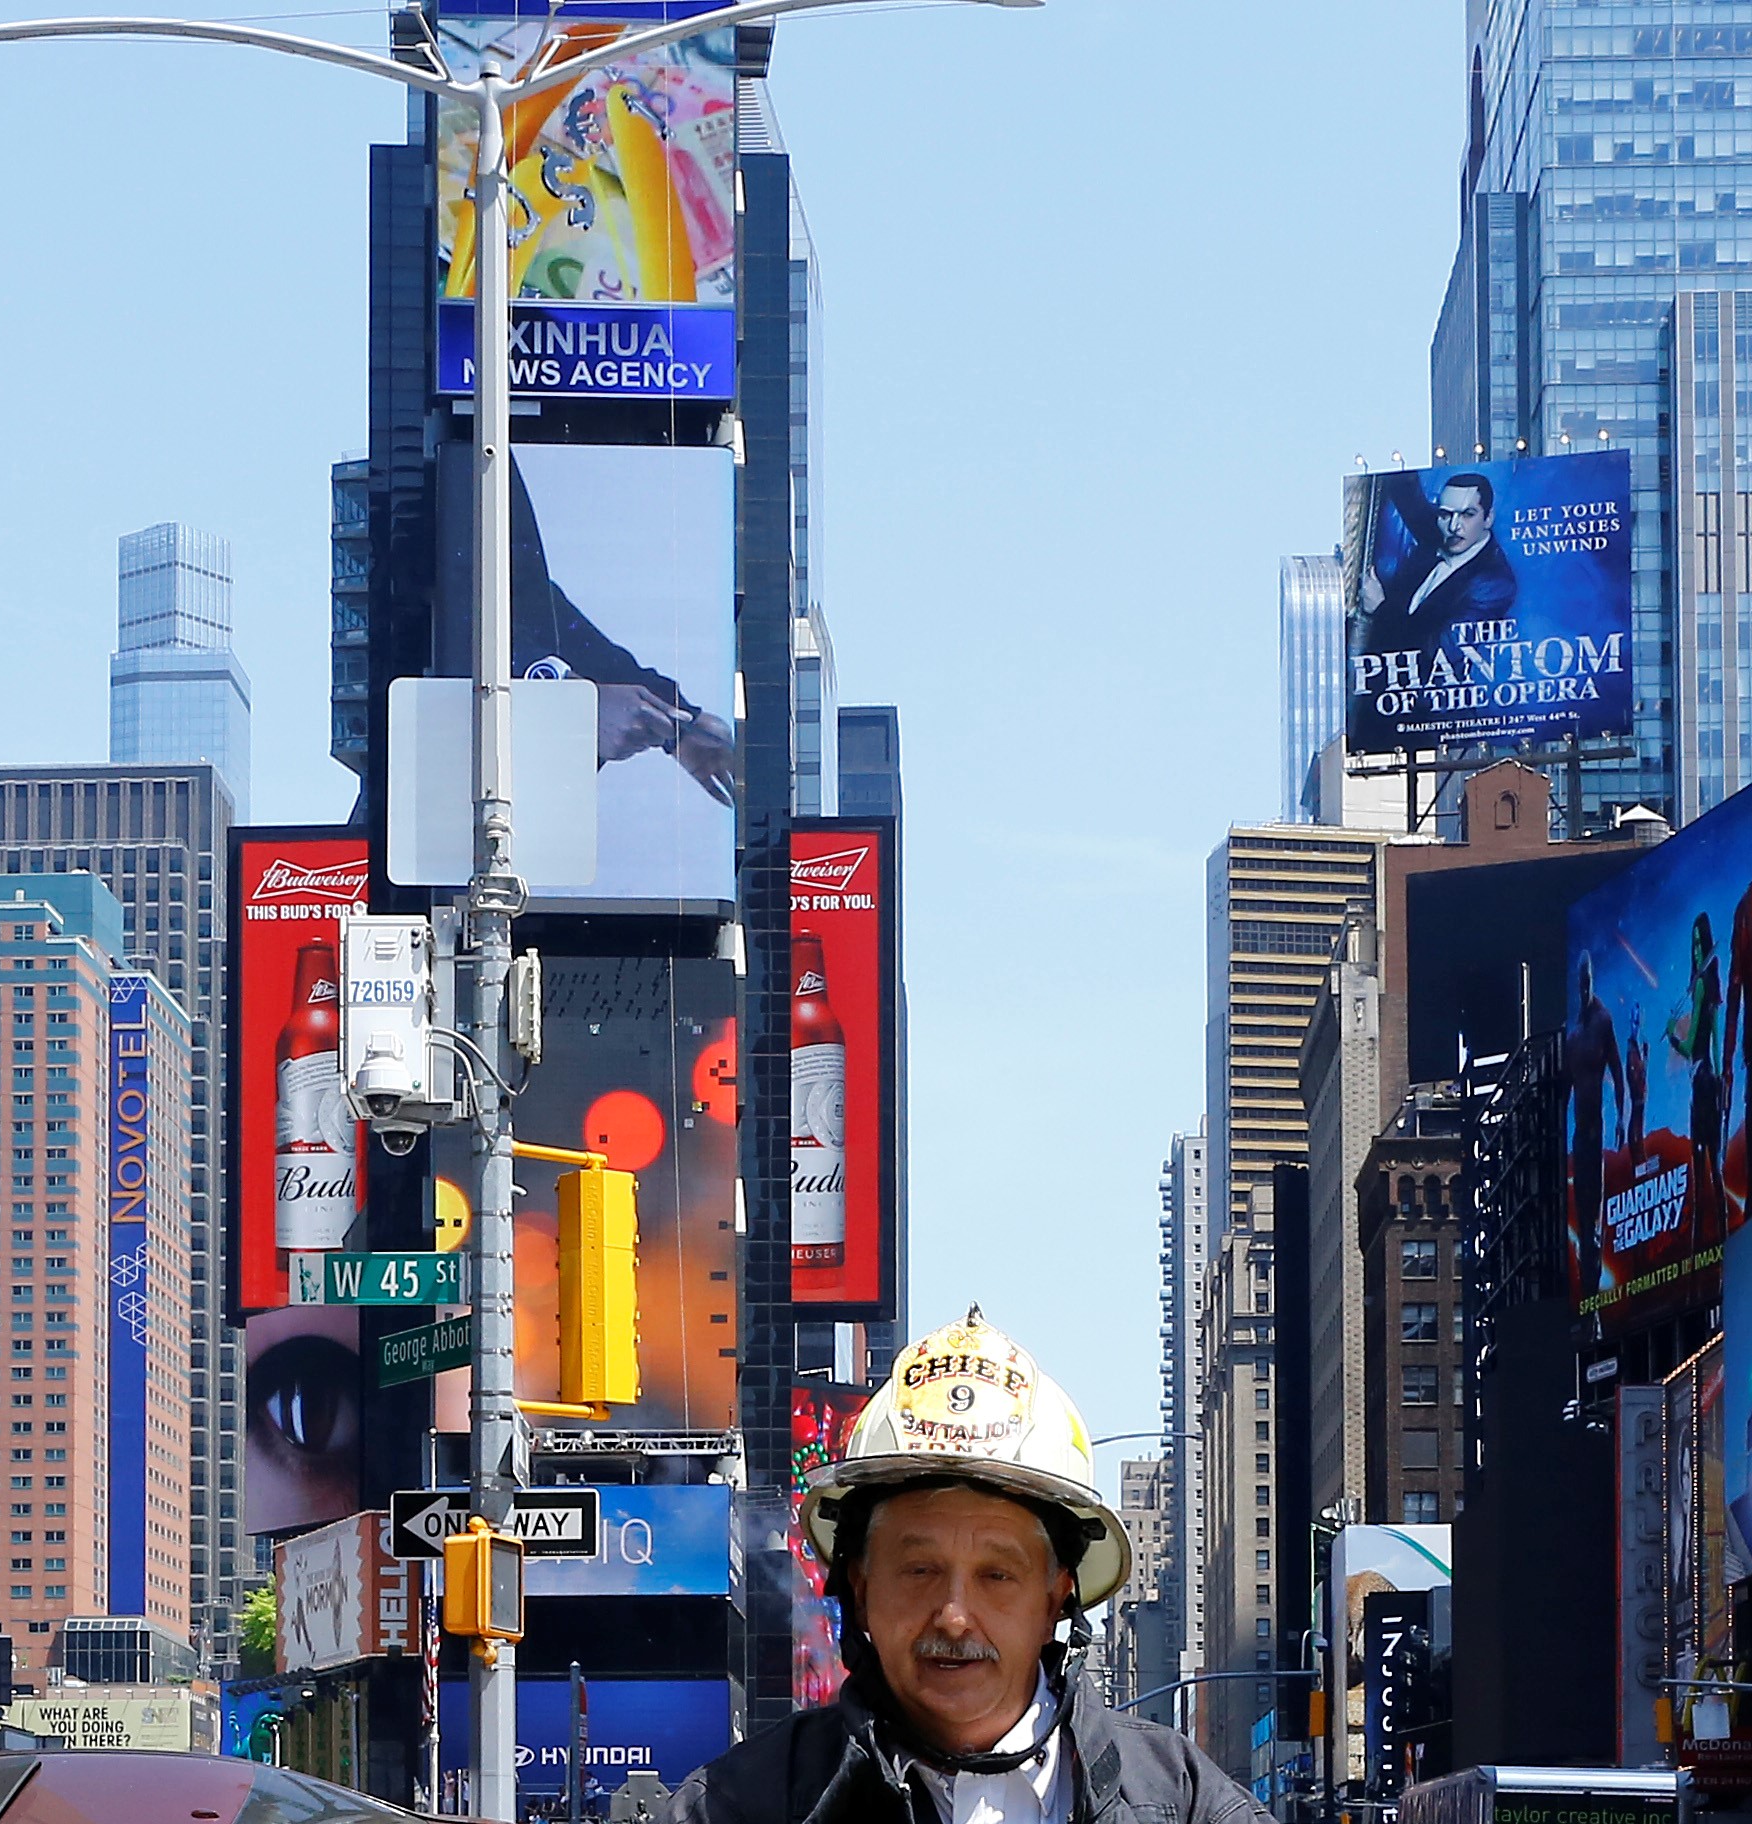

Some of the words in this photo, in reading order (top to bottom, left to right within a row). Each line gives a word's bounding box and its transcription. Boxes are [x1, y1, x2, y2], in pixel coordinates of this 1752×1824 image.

[510, 320, 674, 358] XINHUA
[463, 359, 561, 386] NWS
[570, 361, 713, 390] AGENCY
[1514, 507, 1552, 523] LET
[1561, 501, 1618, 519] YOUR
[1510, 519, 1621, 541] FANTASIES
[1523, 537, 1608, 556] UNWIND
[1452, 618, 1519, 645] THE
[1352, 632, 1624, 696] PHANTOM
[1376, 691, 1414, 715] OF
[1424, 687, 1490, 713] THE
[1492, 676, 1600, 707] OPERA
[1406, 720, 1453, 732] MAJESTIC
[1456, 717, 1501, 728] THEATRE
[1440, 727, 1535, 742] phantombroadway.com
[263, 869, 369, 890] Budweiser
[245, 904, 276, 920] THIS
[281, 904, 322, 920] BUD'S
[813, 894, 840, 910] FOR
[842, 893, 875, 910] YOU.
[112, 1004, 147, 1224] NOVOTEL
[1606, 1163, 1689, 1226] GUARDIANS
[1624, 1196, 1685, 1249] GALAXY
[333, 1261, 362, 1299] W
[381, 1259, 420, 1299] 45
[436, 1259, 457, 1284] St
[1578, 1283, 1623, 1316] SPECIALLY
[1625, 1262, 1680, 1299] FORMATTED
[1694, 1244, 1723, 1272] IMAX
[382, 1332, 427, 1366] George
[432, 1321, 471, 1354] Abbot
[422, 1358, 436, 1373] Way
[903, 1353, 1029, 1398] CHIEF
[947, 1383, 977, 1414] 9
[424, 1512, 469, 1538] ON
[513, 1512, 570, 1537] WAY
[39, 1707, 79, 1720] WHAT
[82, 1707, 109, 1720] ARE
[49, 1720, 77, 1734] YOU
[81, 1720, 125, 1734] DOING
[81, 1735, 131, 1747] THERE?
[1493, 1803, 1551, 1824] taylor
